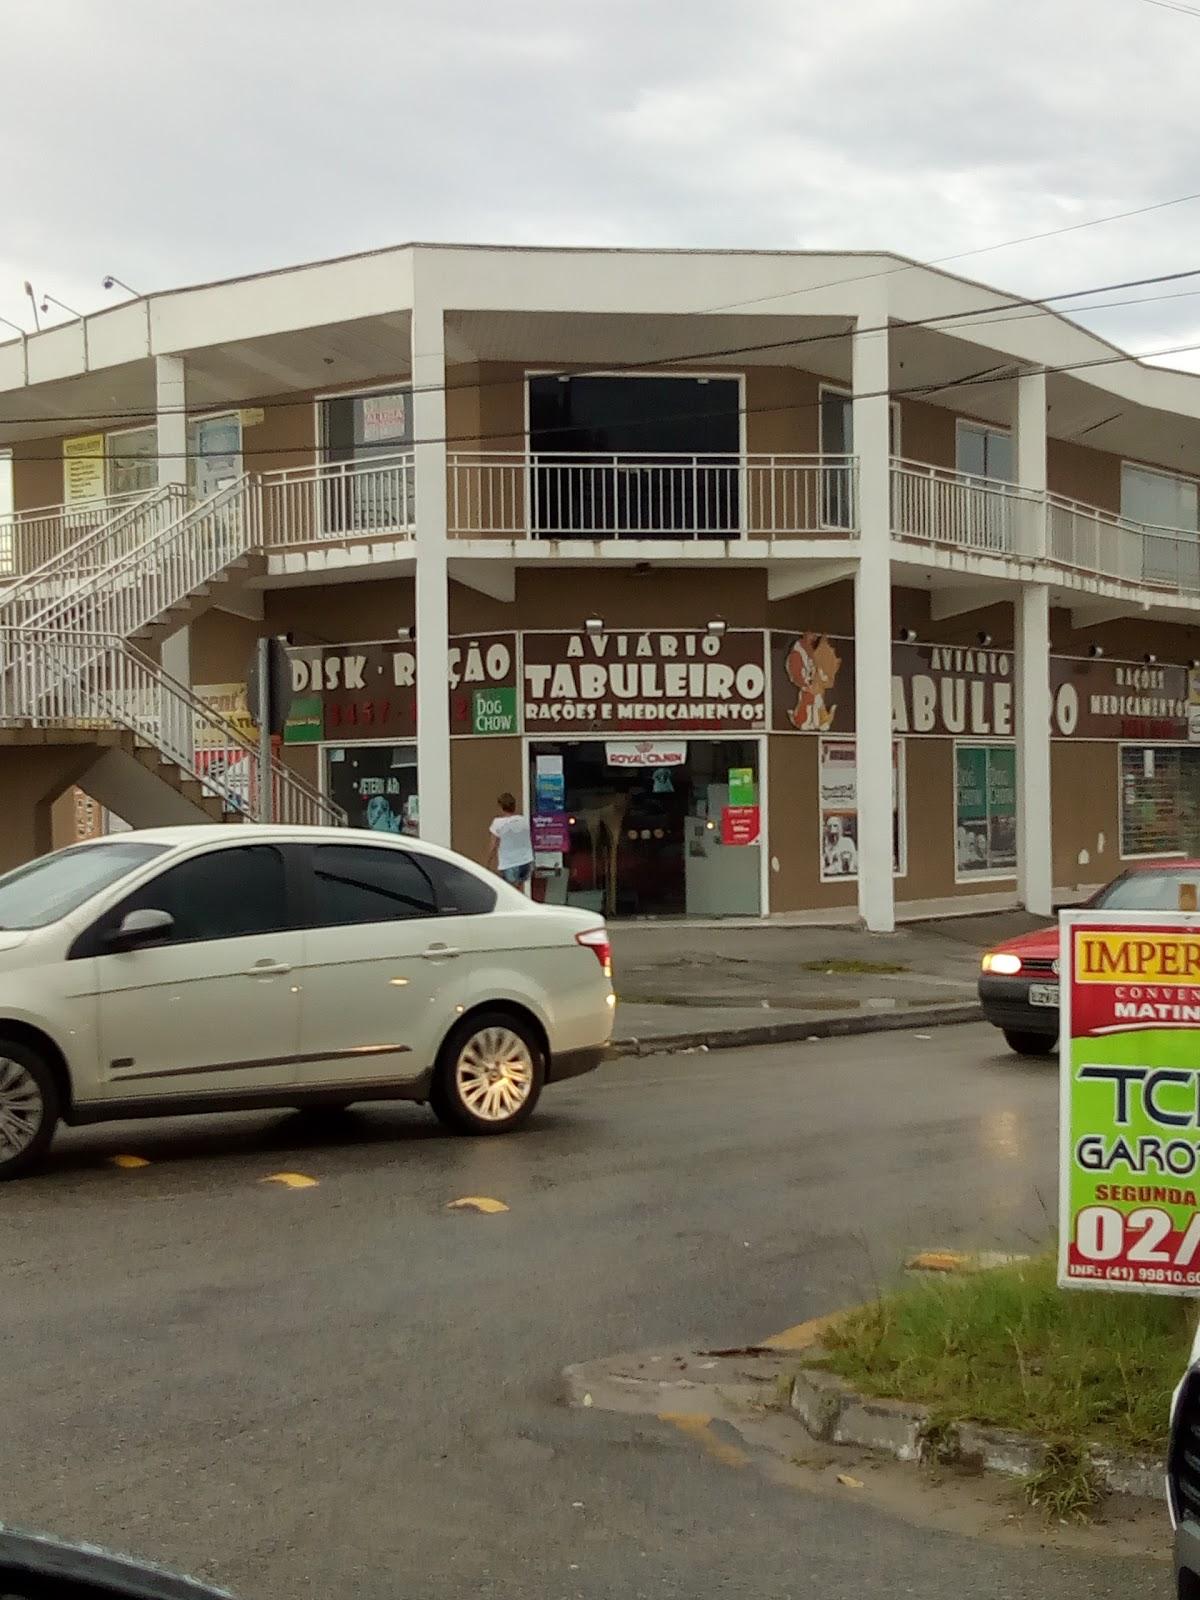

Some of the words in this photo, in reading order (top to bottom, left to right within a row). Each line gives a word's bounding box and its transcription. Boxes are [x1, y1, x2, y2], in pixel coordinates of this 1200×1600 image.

[567, 632, 721, 657] AVIÁRIO
[291, 655, 366, 692] DISK
[393, 641, 511, 690] RÇÃO
[525, 663, 765, 700] TABULEIRO
[477, 698, 503, 715] DOG
[525, 700, 596, 721] RAÇÕES
[601, 703, 612, 719] E
[617, 702, 764, 720] MEDICAMENTOS
[476, 715, 513, 731] CHOW
[1077, 1065, 1200, 1129] TC
[1078, 1135, 1200, 1175] GARO
[1095, 1184, 1197, 1206] SEGUNDA
[1106, 1266, 1135, 1281] (41)
